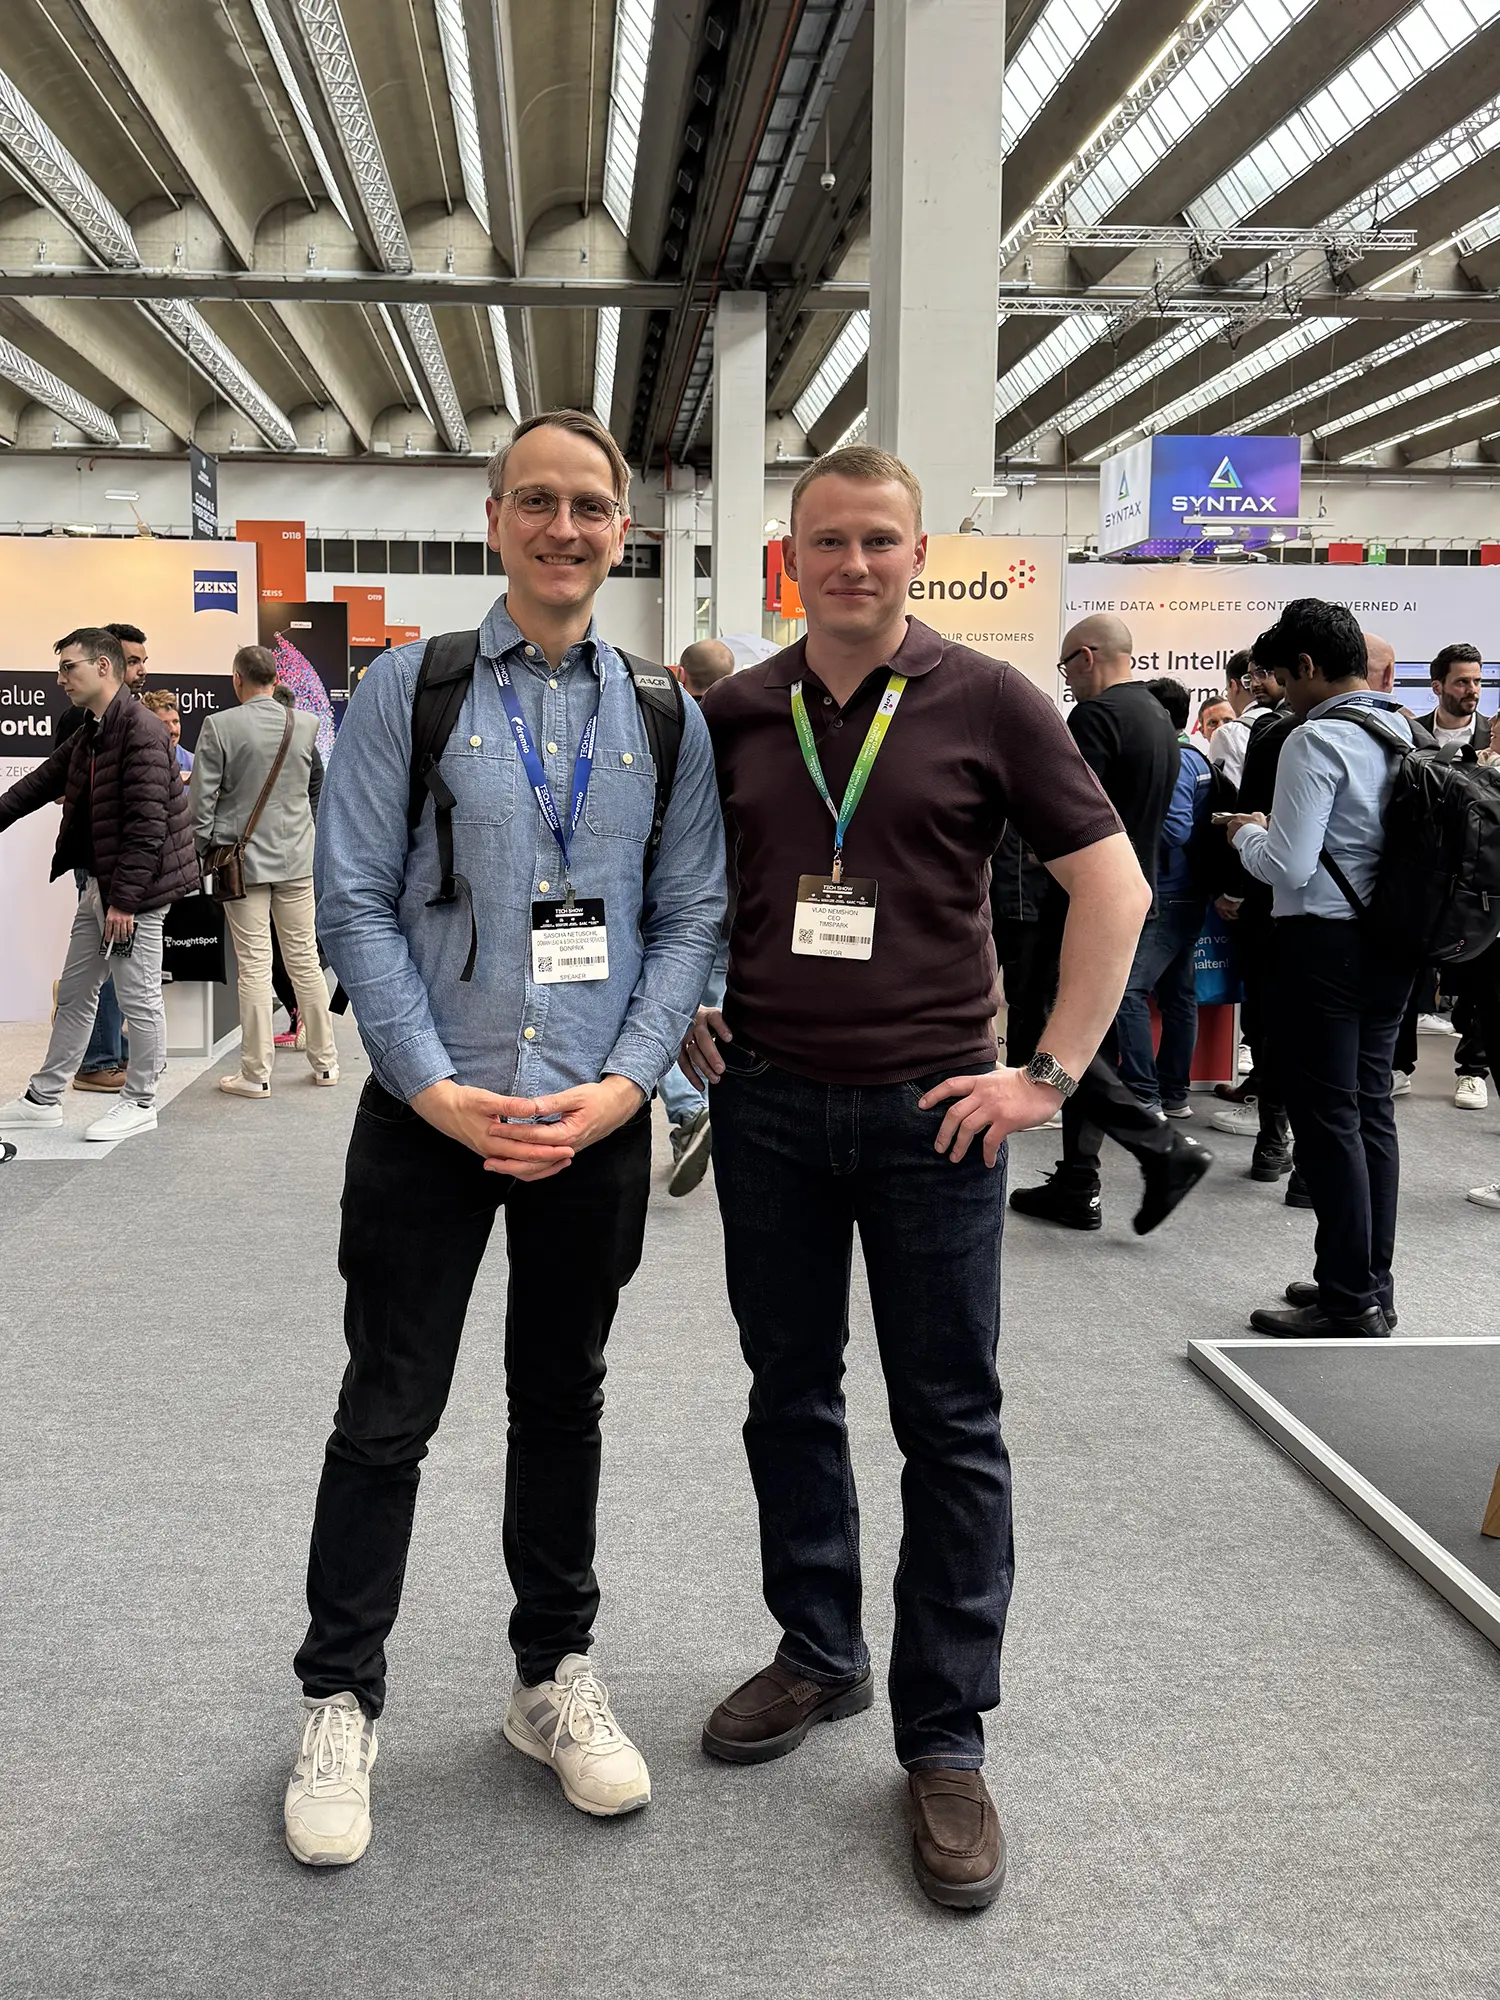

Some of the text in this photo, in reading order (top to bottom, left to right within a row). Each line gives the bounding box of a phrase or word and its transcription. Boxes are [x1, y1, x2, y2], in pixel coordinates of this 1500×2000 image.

[1171, 495, 1277, 513] SYNTAX
[1104, 501, 1142, 528] SYNTAX
[281, 531, 302, 540] D118
[194, 581, 237, 594] ZEISS
[261, 589, 283, 597] ZEISS
[907, 571, 1009, 601] enodo
[1066, 601, 1115, 611] L-TIME
[1120, 601, 1155, 611] DATA
[1168, 601, 1242, 611] COMPLETE
[1327, 601, 1399, 611] OVERNED
[1403, 601, 1417, 611] AI
[965, 632, 1035, 642] CUSTOMERS
[499, 663, 511, 686] SHOW
[0, 684, 46, 706] alue
[175, 688, 220, 713] ight.
[515, 725, 530, 754] dremio
[580, 739, 589, 758] TECH
[540, 784, 560, 828] TECH SHOW
[573, 791, 584, 821] dremio
[164, 936, 218, 947] ThoughtSpot
